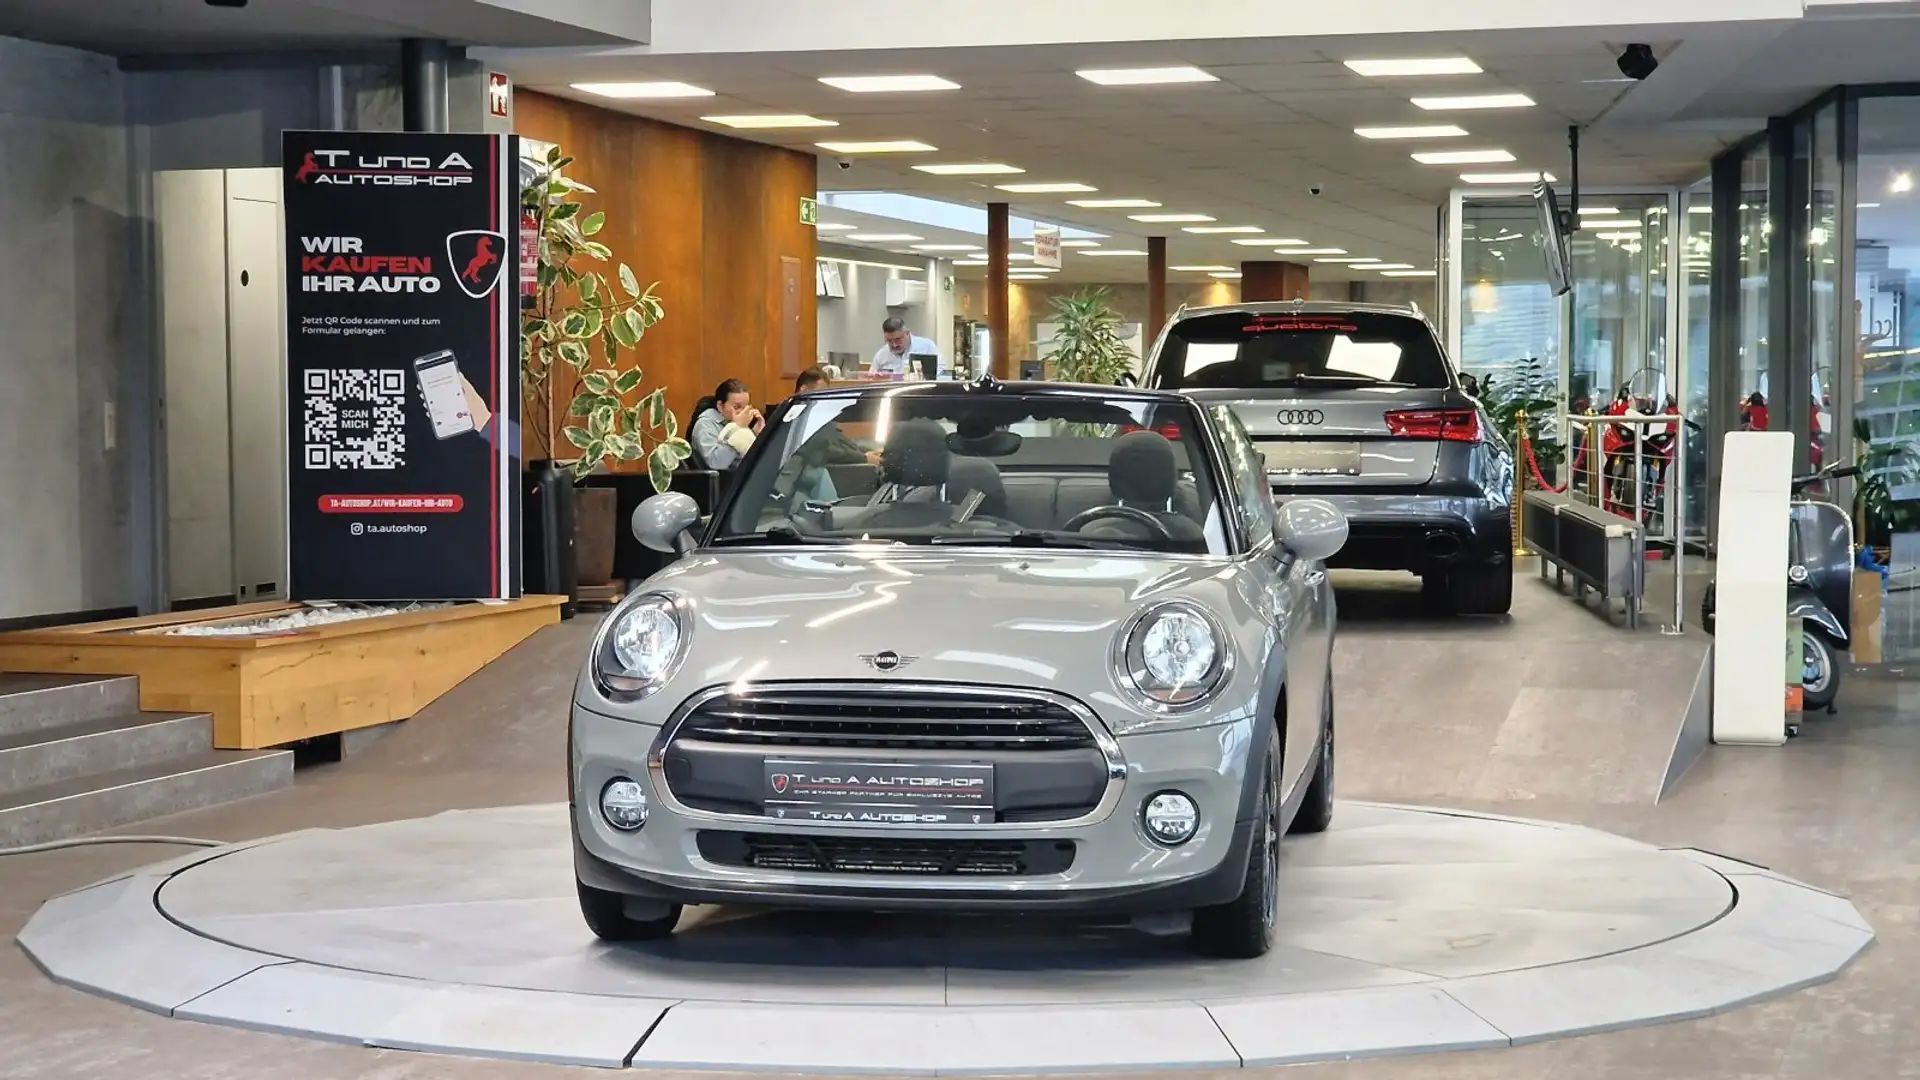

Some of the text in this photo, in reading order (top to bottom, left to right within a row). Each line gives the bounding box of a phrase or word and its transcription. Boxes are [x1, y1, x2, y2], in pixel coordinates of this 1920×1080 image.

[314, 150, 350, 167] T
[438, 152, 473, 169] A
[314, 174, 473, 186] AUTOSHOP
[301, 236, 363, 253] WIR
[302, 256, 431, 273] KAUFEN
[302, 276, 441, 293] IHR AUTO
[325, 317, 338, 325] QR
[340, 317, 362, 325] Code
[342, 410, 369, 418] SCAN
[341, 420, 369, 429] MICH
[367, 524, 427, 534] ta.autoshop
[867, 776, 984, 786] AUTOSHOP
[860, 813, 947, 821] AUTOSHOP
